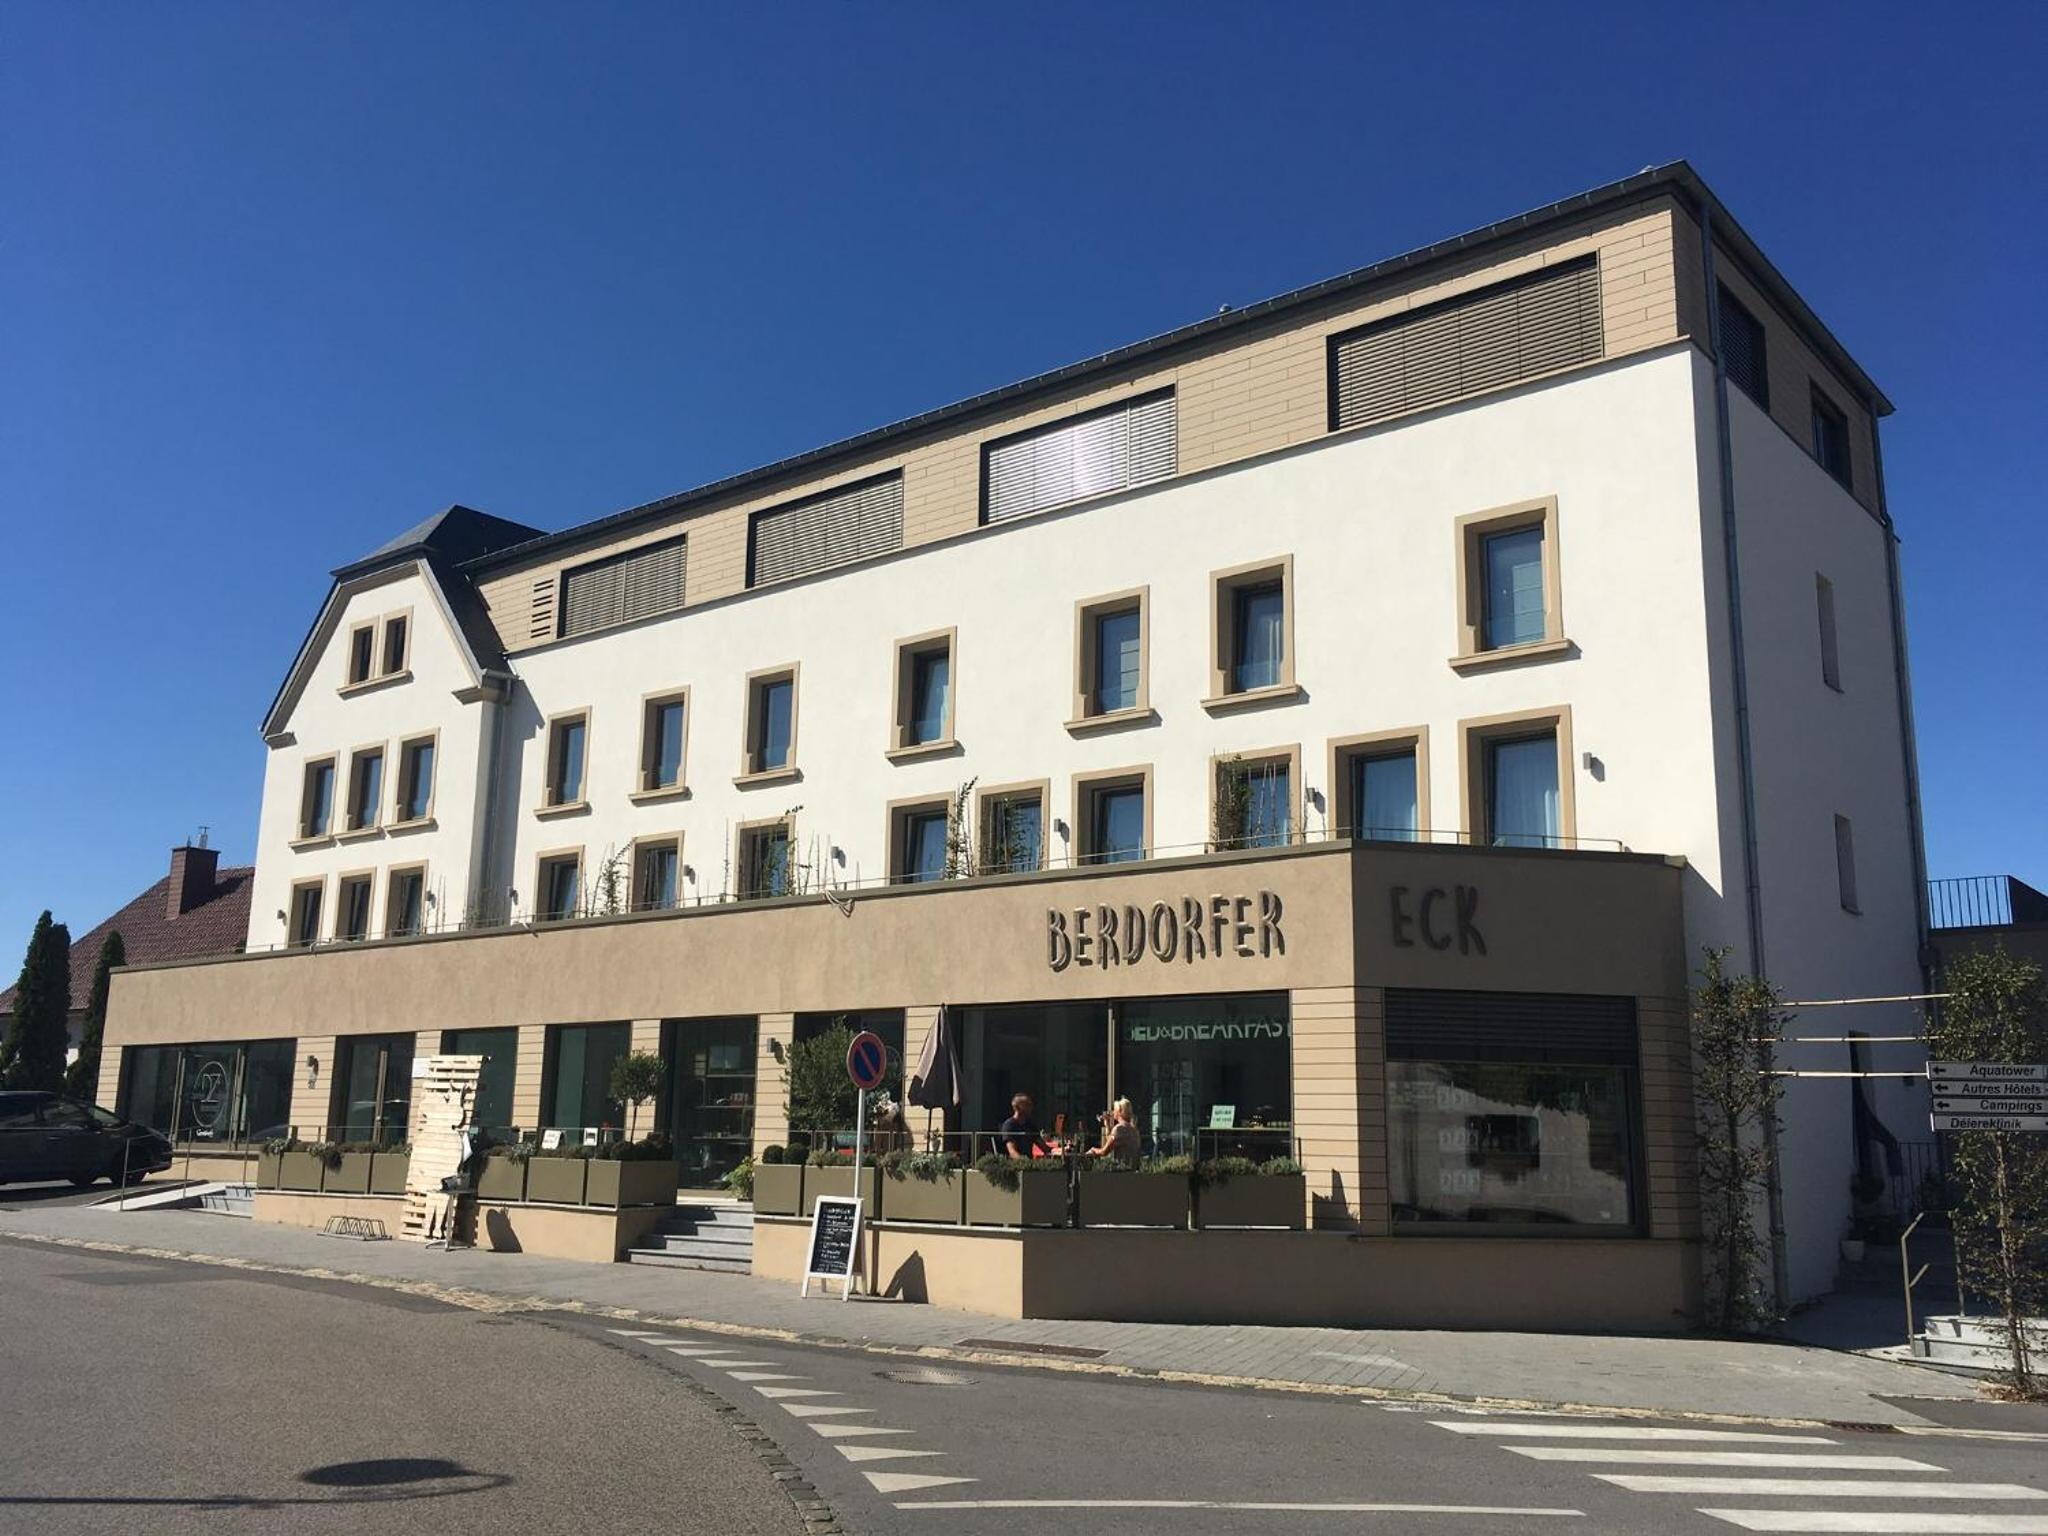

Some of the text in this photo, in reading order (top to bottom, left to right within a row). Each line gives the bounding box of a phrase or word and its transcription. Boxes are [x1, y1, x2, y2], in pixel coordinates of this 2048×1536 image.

[1047, 884, 1487, 972] BERDORFER ECK
[1970, 1065, 2035, 1077] Aquatower
[1962, 1083, 2041, 1094] Autres Hôtels
[1980, 1100, 2042, 1112] Campings
